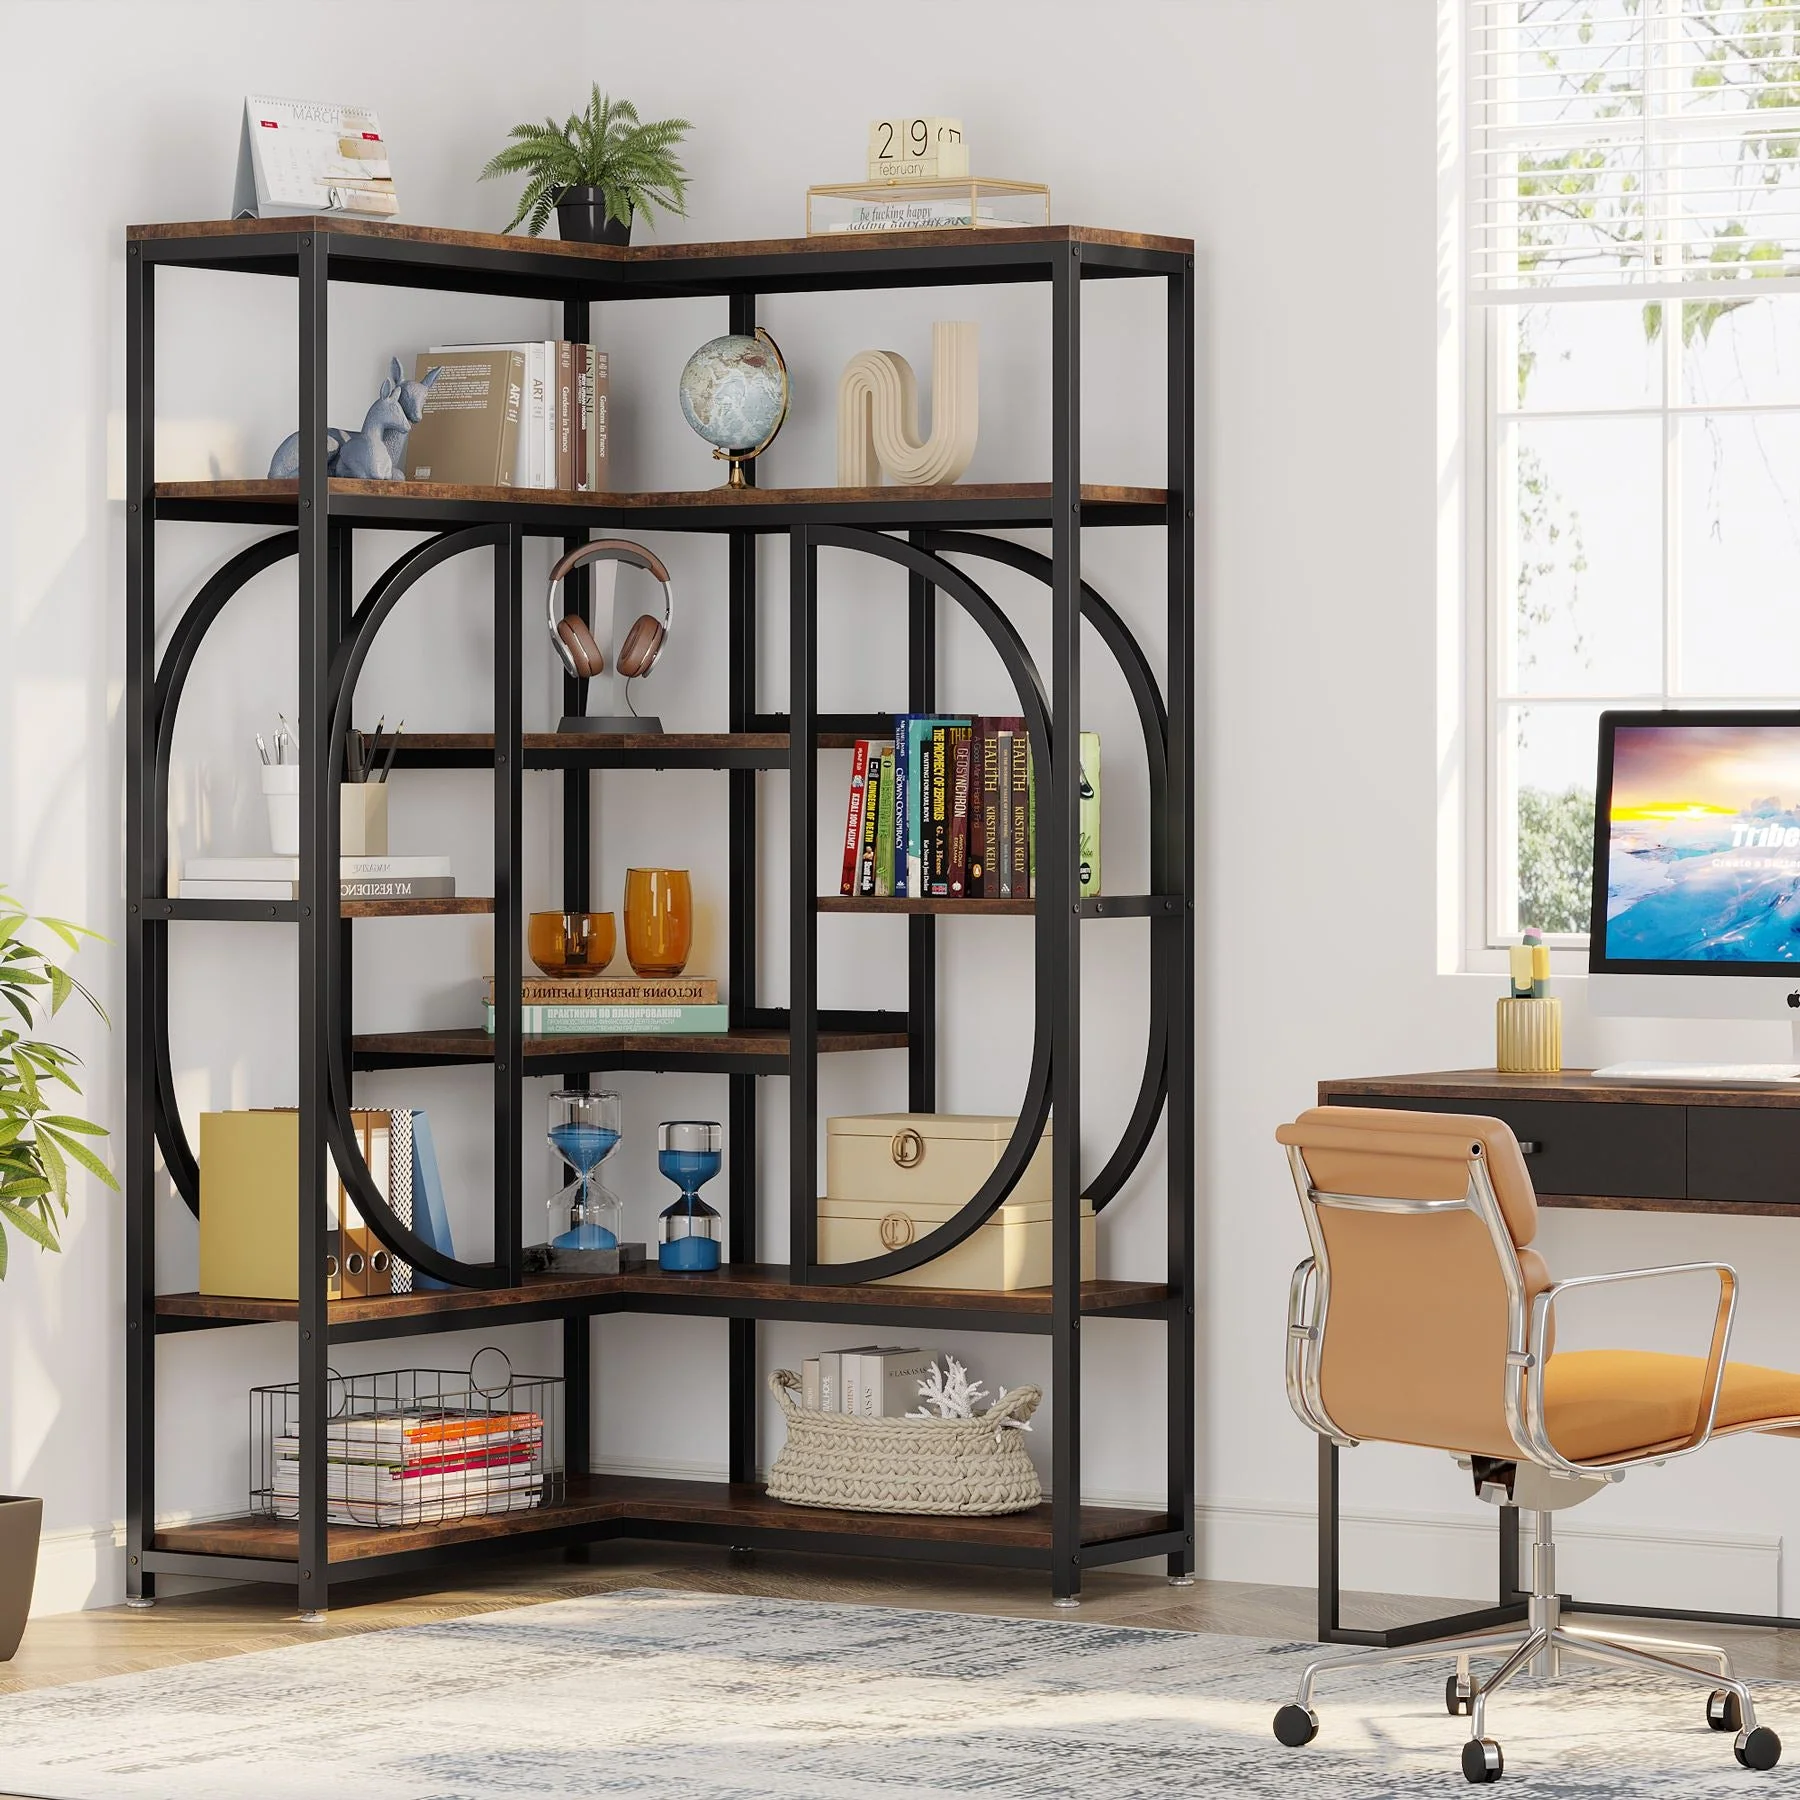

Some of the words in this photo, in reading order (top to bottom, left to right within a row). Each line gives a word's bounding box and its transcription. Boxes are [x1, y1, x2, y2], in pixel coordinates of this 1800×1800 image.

[293, 108, 339, 126] MARCH
[879, 163, 925, 177] february
[860, 207, 870, 221] be
[872, 205, 904, 221] fucking
[906, 204, 933, 220] happy
[509, 383, 521, 407] ART
[533, 379, 543, 402] ART
[562, 386, 570, 416] Gardens
[599, 395, 607, 424] Gardens
[562, 427, 570, 453] France
[599, 434, 607, 458] France
[933, 729, 945, 742] THE
[933, 742, 945, 776] PROPHECY
[973, 743, 981, 763] Good
[896, 767, 904, 800] CROWN
[933, 777, 945, 787] OF
[954, 747, 969, 818] GEOSYNCHRON
[851, 793, 860, 812] KEDAI
[866, 780, 878, 811] DUNGEON
[933, 787, 945, 821] ZEPHYRUS
[849, 814, 858, 828] 1001
[866, 812, 875, 821] OF
[895, 801, 904, 850] CONSPIRACY
[986, 806, 997, 844] KIRSTEN
[1014, 806, 1025, 844] KIRSTEN
[847, 829, 857, 849] MIMPI
[865, 822, 875, 843] DEATH
[935, 825, 943, 836] G.
[1731, 822, 1800, 848] Tribe
[935, 837, 943, 848] A.
[935, 849, 944, 875] Hesse
[986, 847, 997, 873] KELLY
[1014, 847, 1025, 873] KELLY
[533, 987, 582, 998] ГРЕЦИИ
[584, 987, 640, 1000] ДРЕВНЕЙ
[643, 987, 703, 998] ИСТОРИЯ
[547, 1008, 598, 1018] ПРАКТИКУМ
[599, 1008, 611, 1018] ПО
[612, 1008, 682, 1018] ПЛАНИРОВАНИЮ
